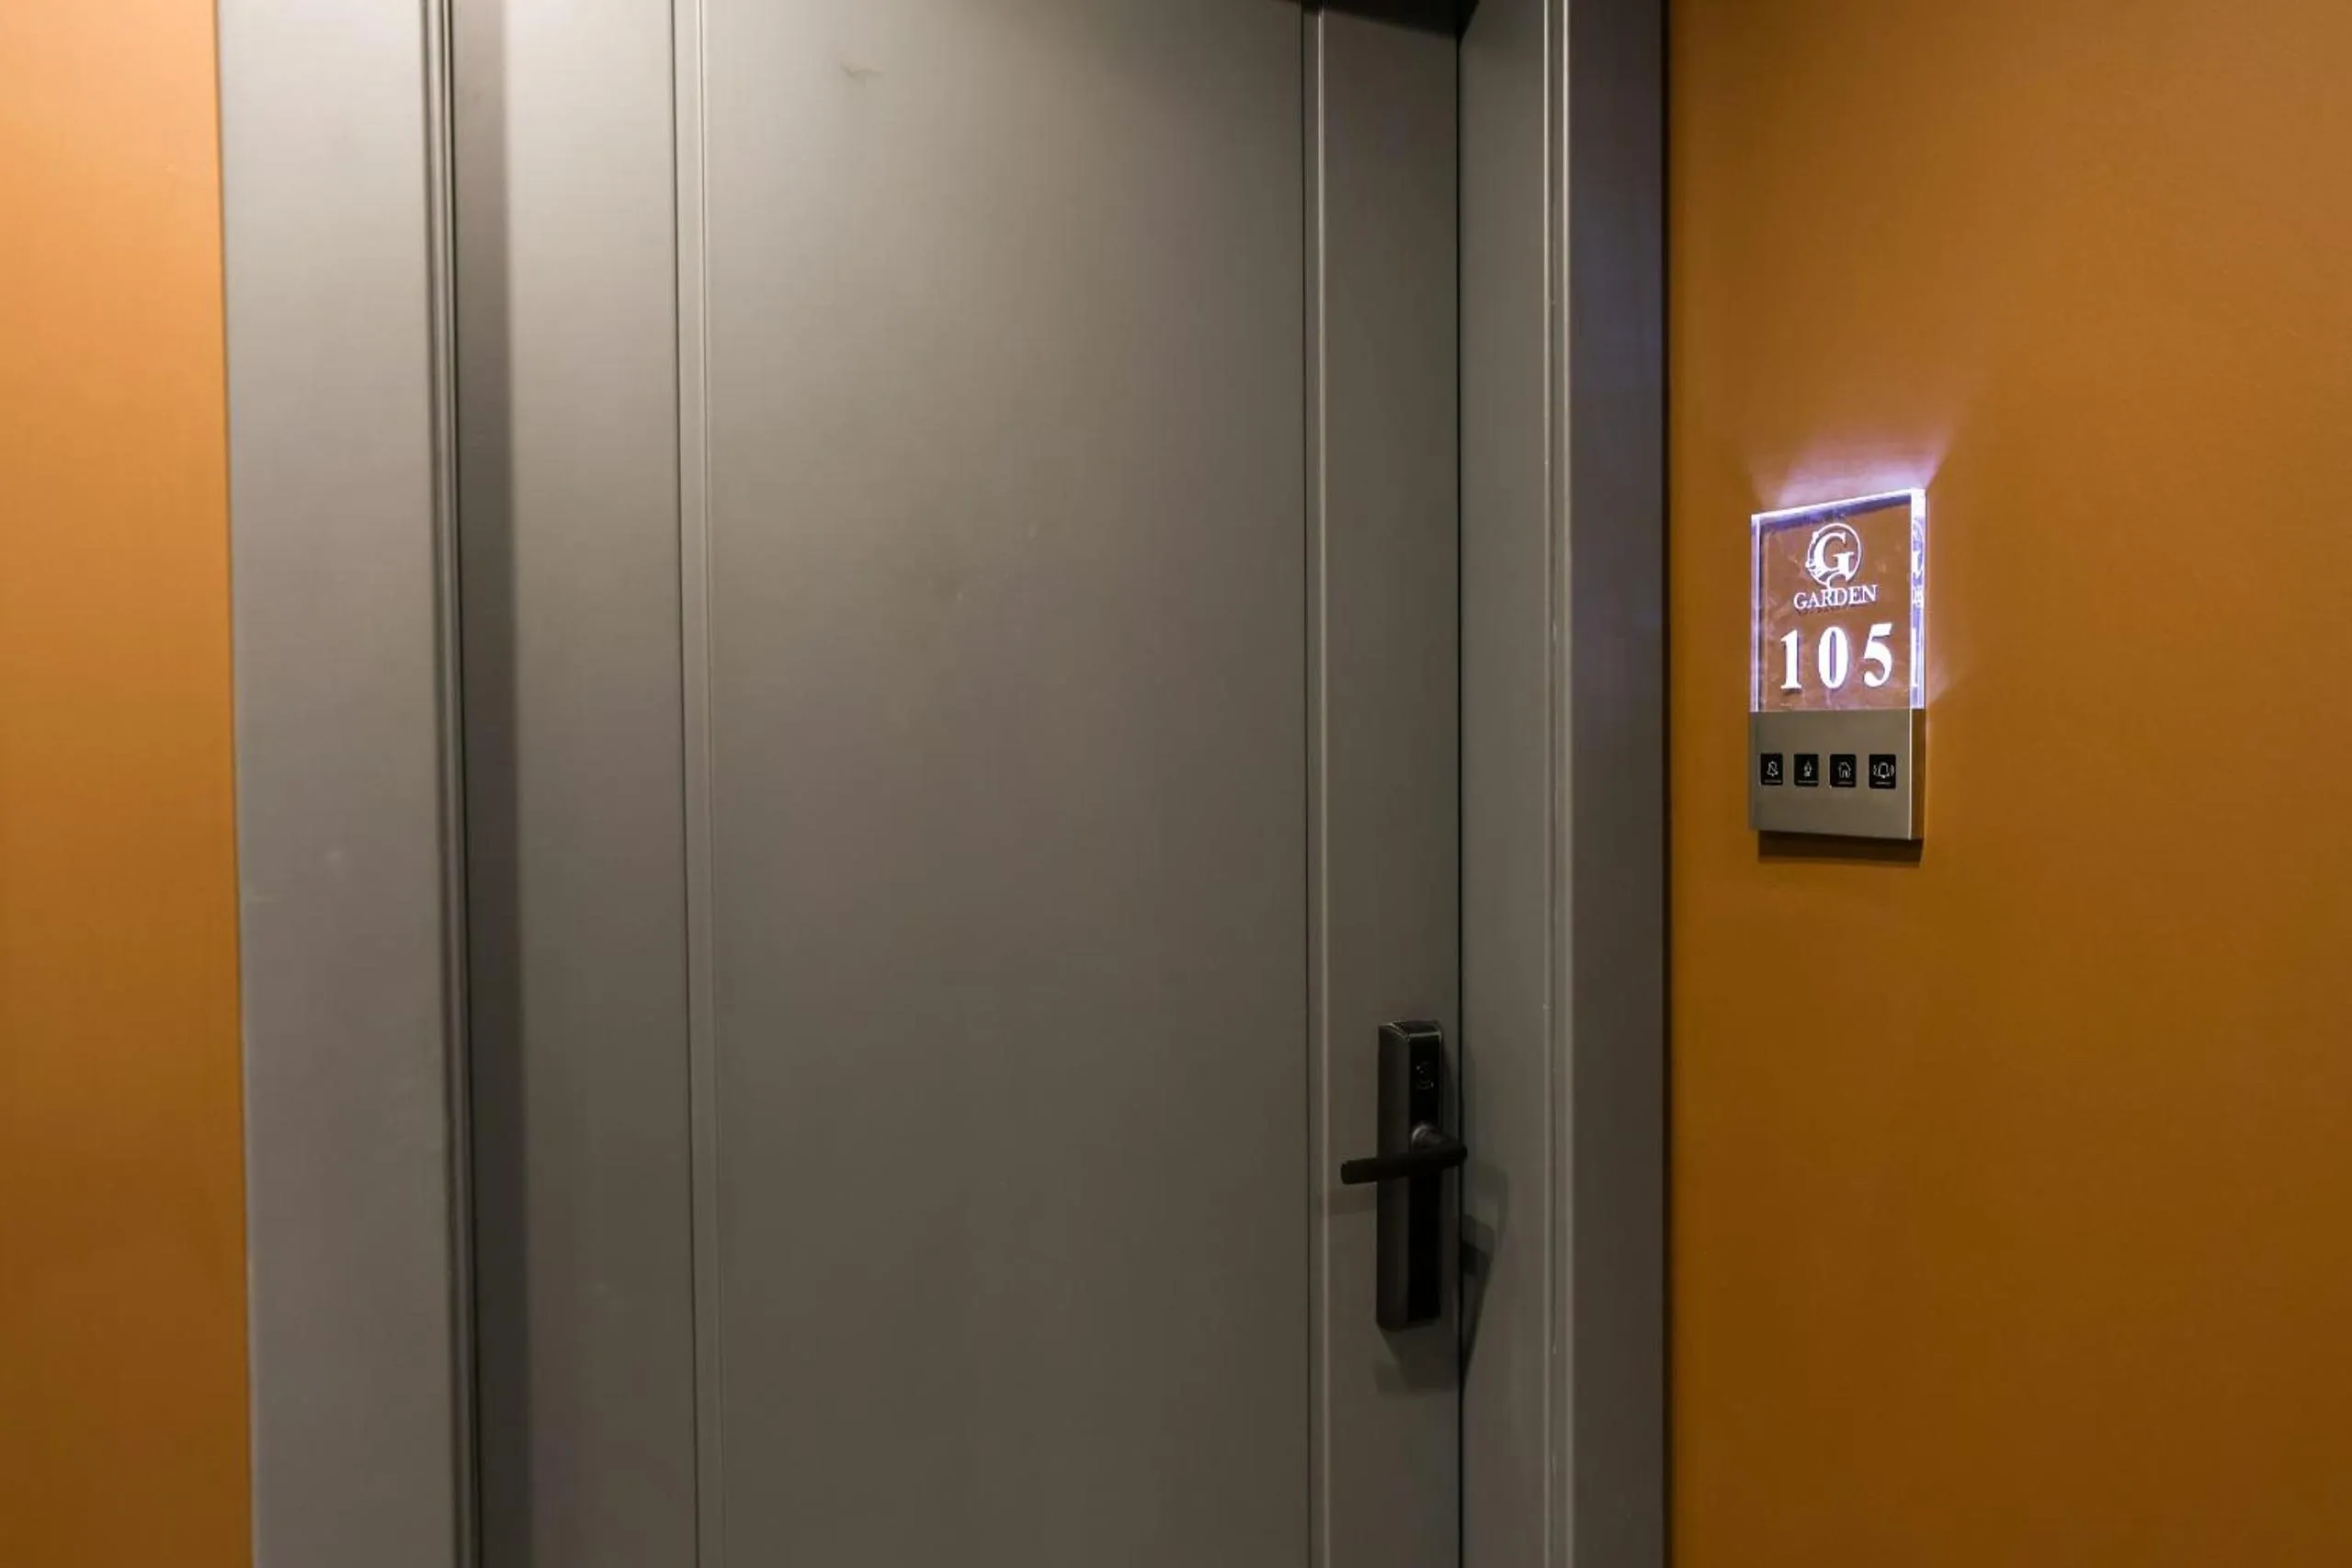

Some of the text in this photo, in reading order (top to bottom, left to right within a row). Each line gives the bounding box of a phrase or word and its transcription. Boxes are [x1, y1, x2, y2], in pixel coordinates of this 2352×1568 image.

[1812, 529, 1856, 585] G
[1793, 585, 1879, 609] GARDEN
[1780, 622, 1893, 689] 105
